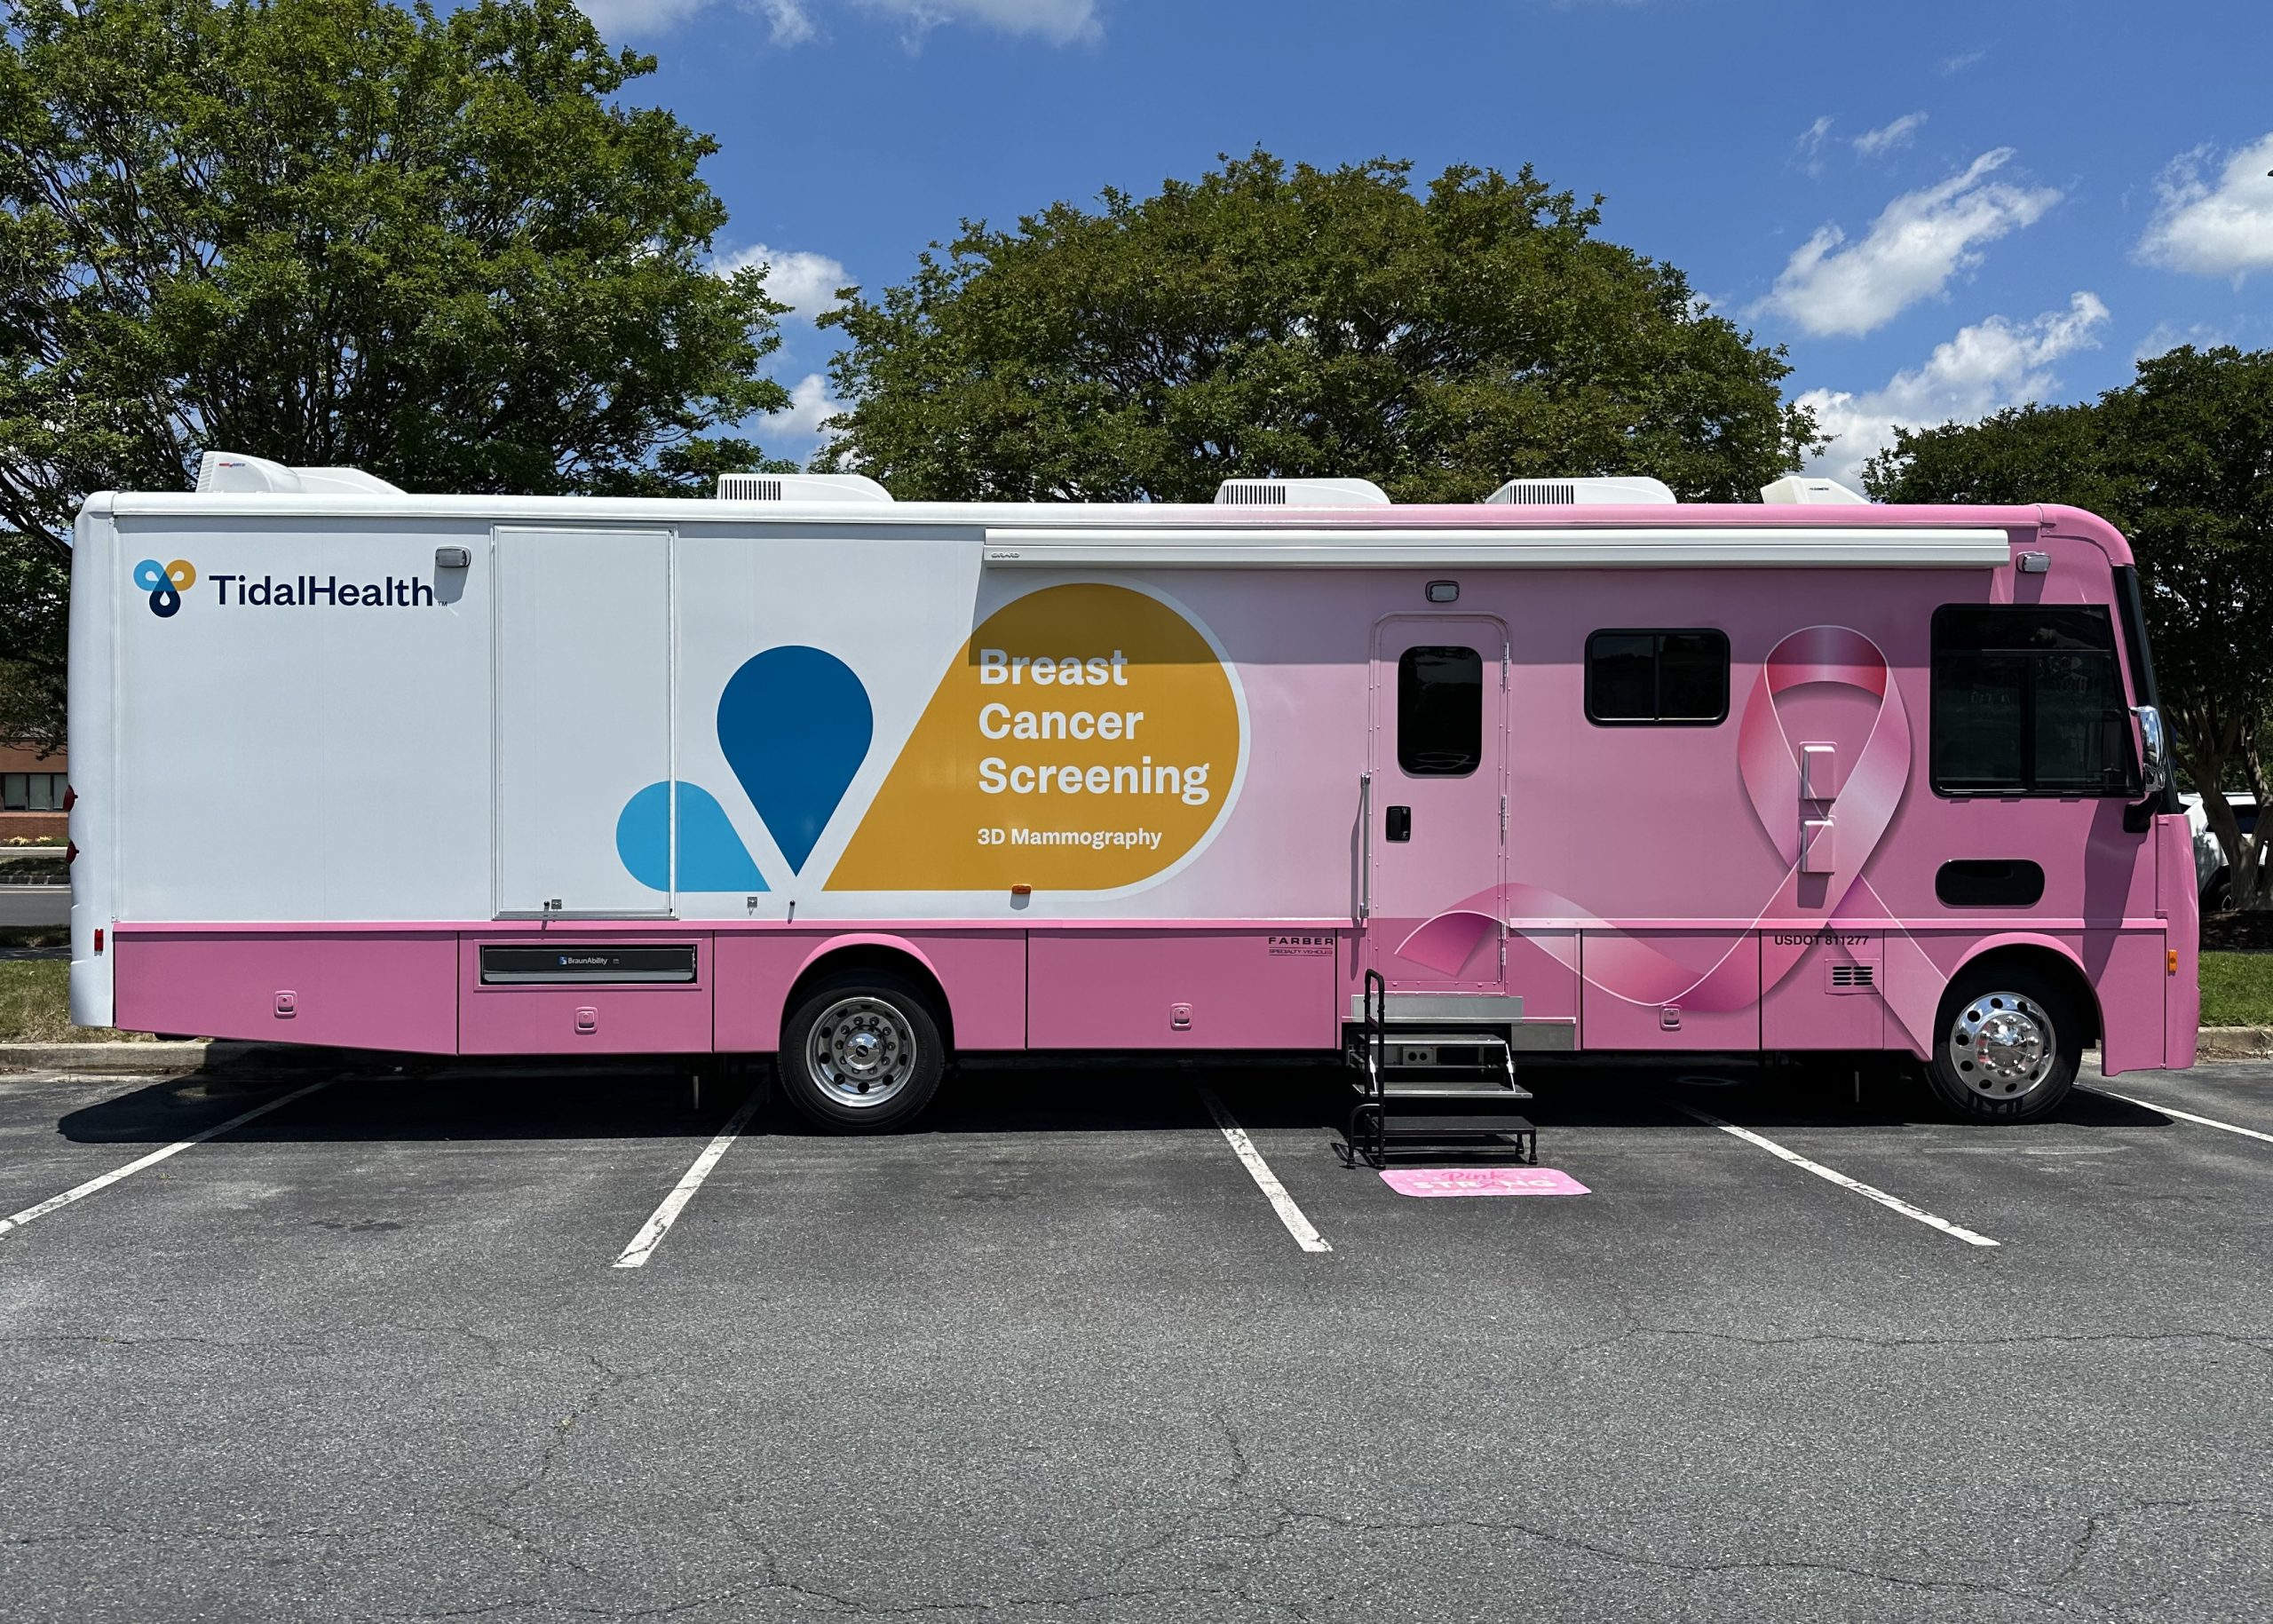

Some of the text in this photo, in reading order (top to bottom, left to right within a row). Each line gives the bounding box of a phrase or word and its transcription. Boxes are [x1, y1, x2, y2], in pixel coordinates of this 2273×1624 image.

[209, 574, 433, 606] TidalHealth
[980, 649, 1129, 685] Breast
[978, 702, 1144, 740] Cancer
[978, 756, 1210, 805] Screening
[978, 828, 1162, 850] 3D Mammography
[1268, 937, 1334, 946] FARBER
[1774, 935, 1869, 946] USDOT 811277
[568, 957, 607, 966] BraunAbility
[1441, 1170, 1505, 1182] Pink
